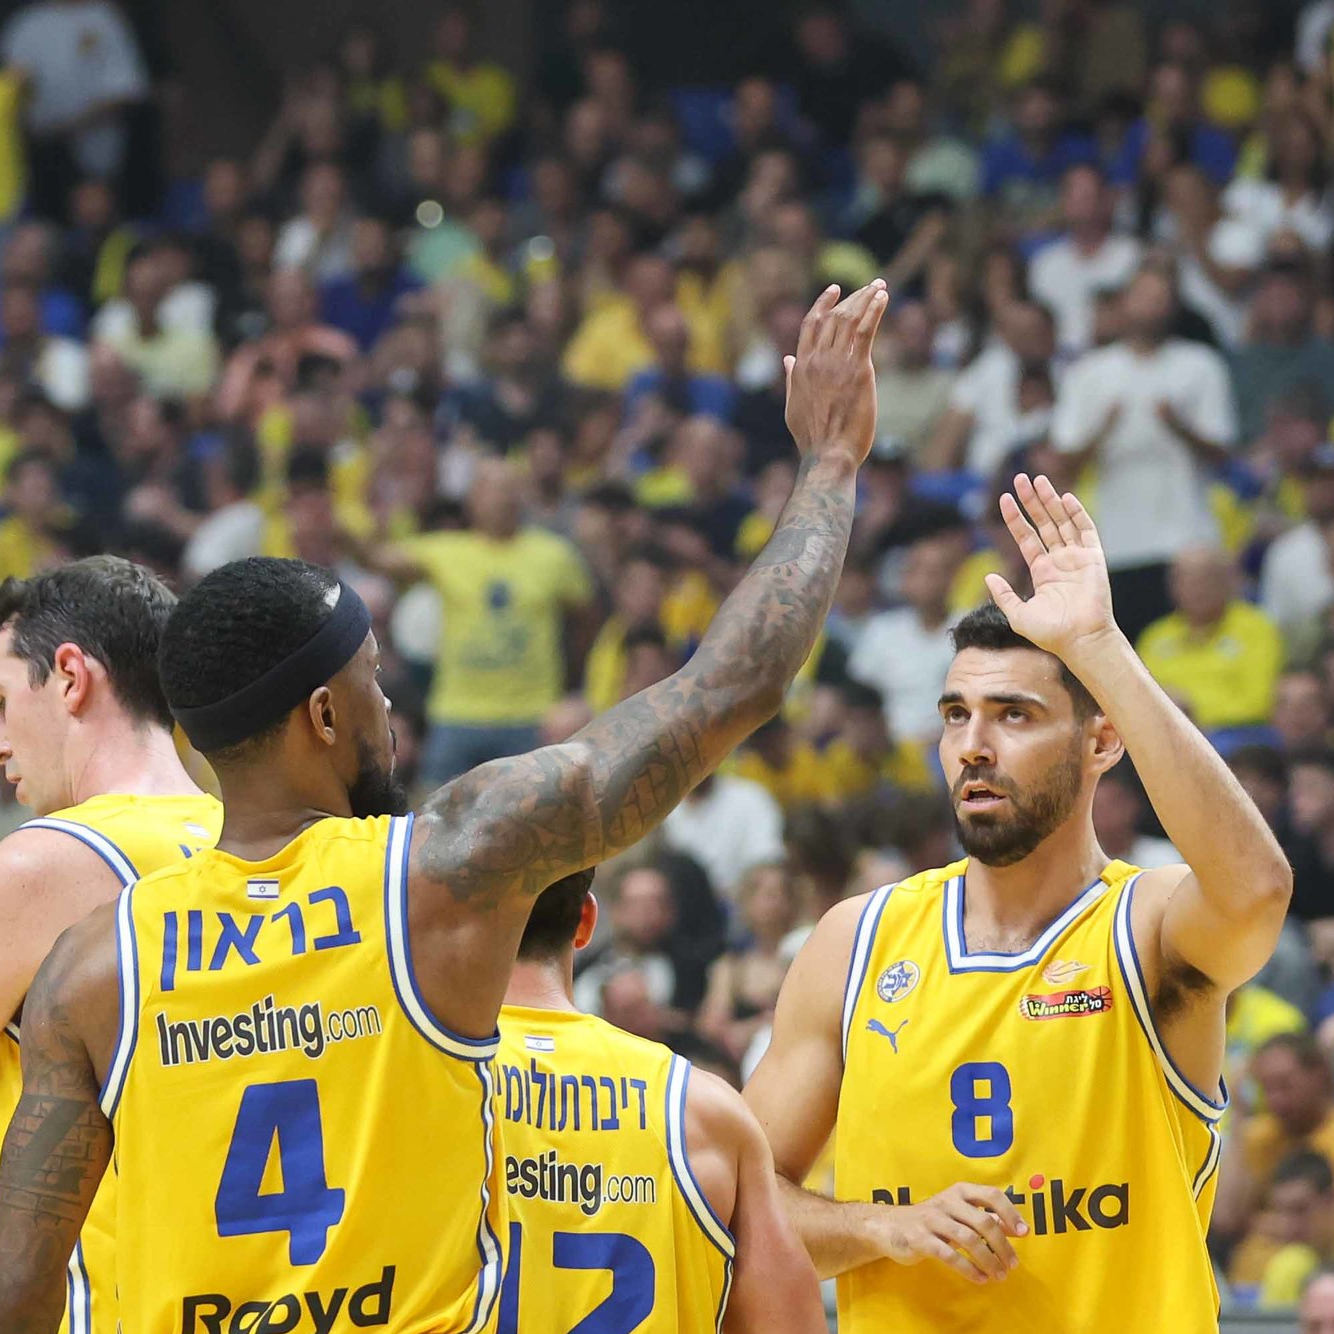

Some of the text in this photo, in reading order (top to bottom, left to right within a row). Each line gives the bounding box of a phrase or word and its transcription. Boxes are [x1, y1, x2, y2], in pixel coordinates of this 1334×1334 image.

[160, 885, 362, 992] בראון
[156, 995, 382, 1066] Investing.com
[496, 1057, 648, 1132] דיברתולומי
[950, 1061, 1014, 1158] 8
[214, 1078, 346, 1267] 4
[504, 1150, 657, 1216] esting.com
